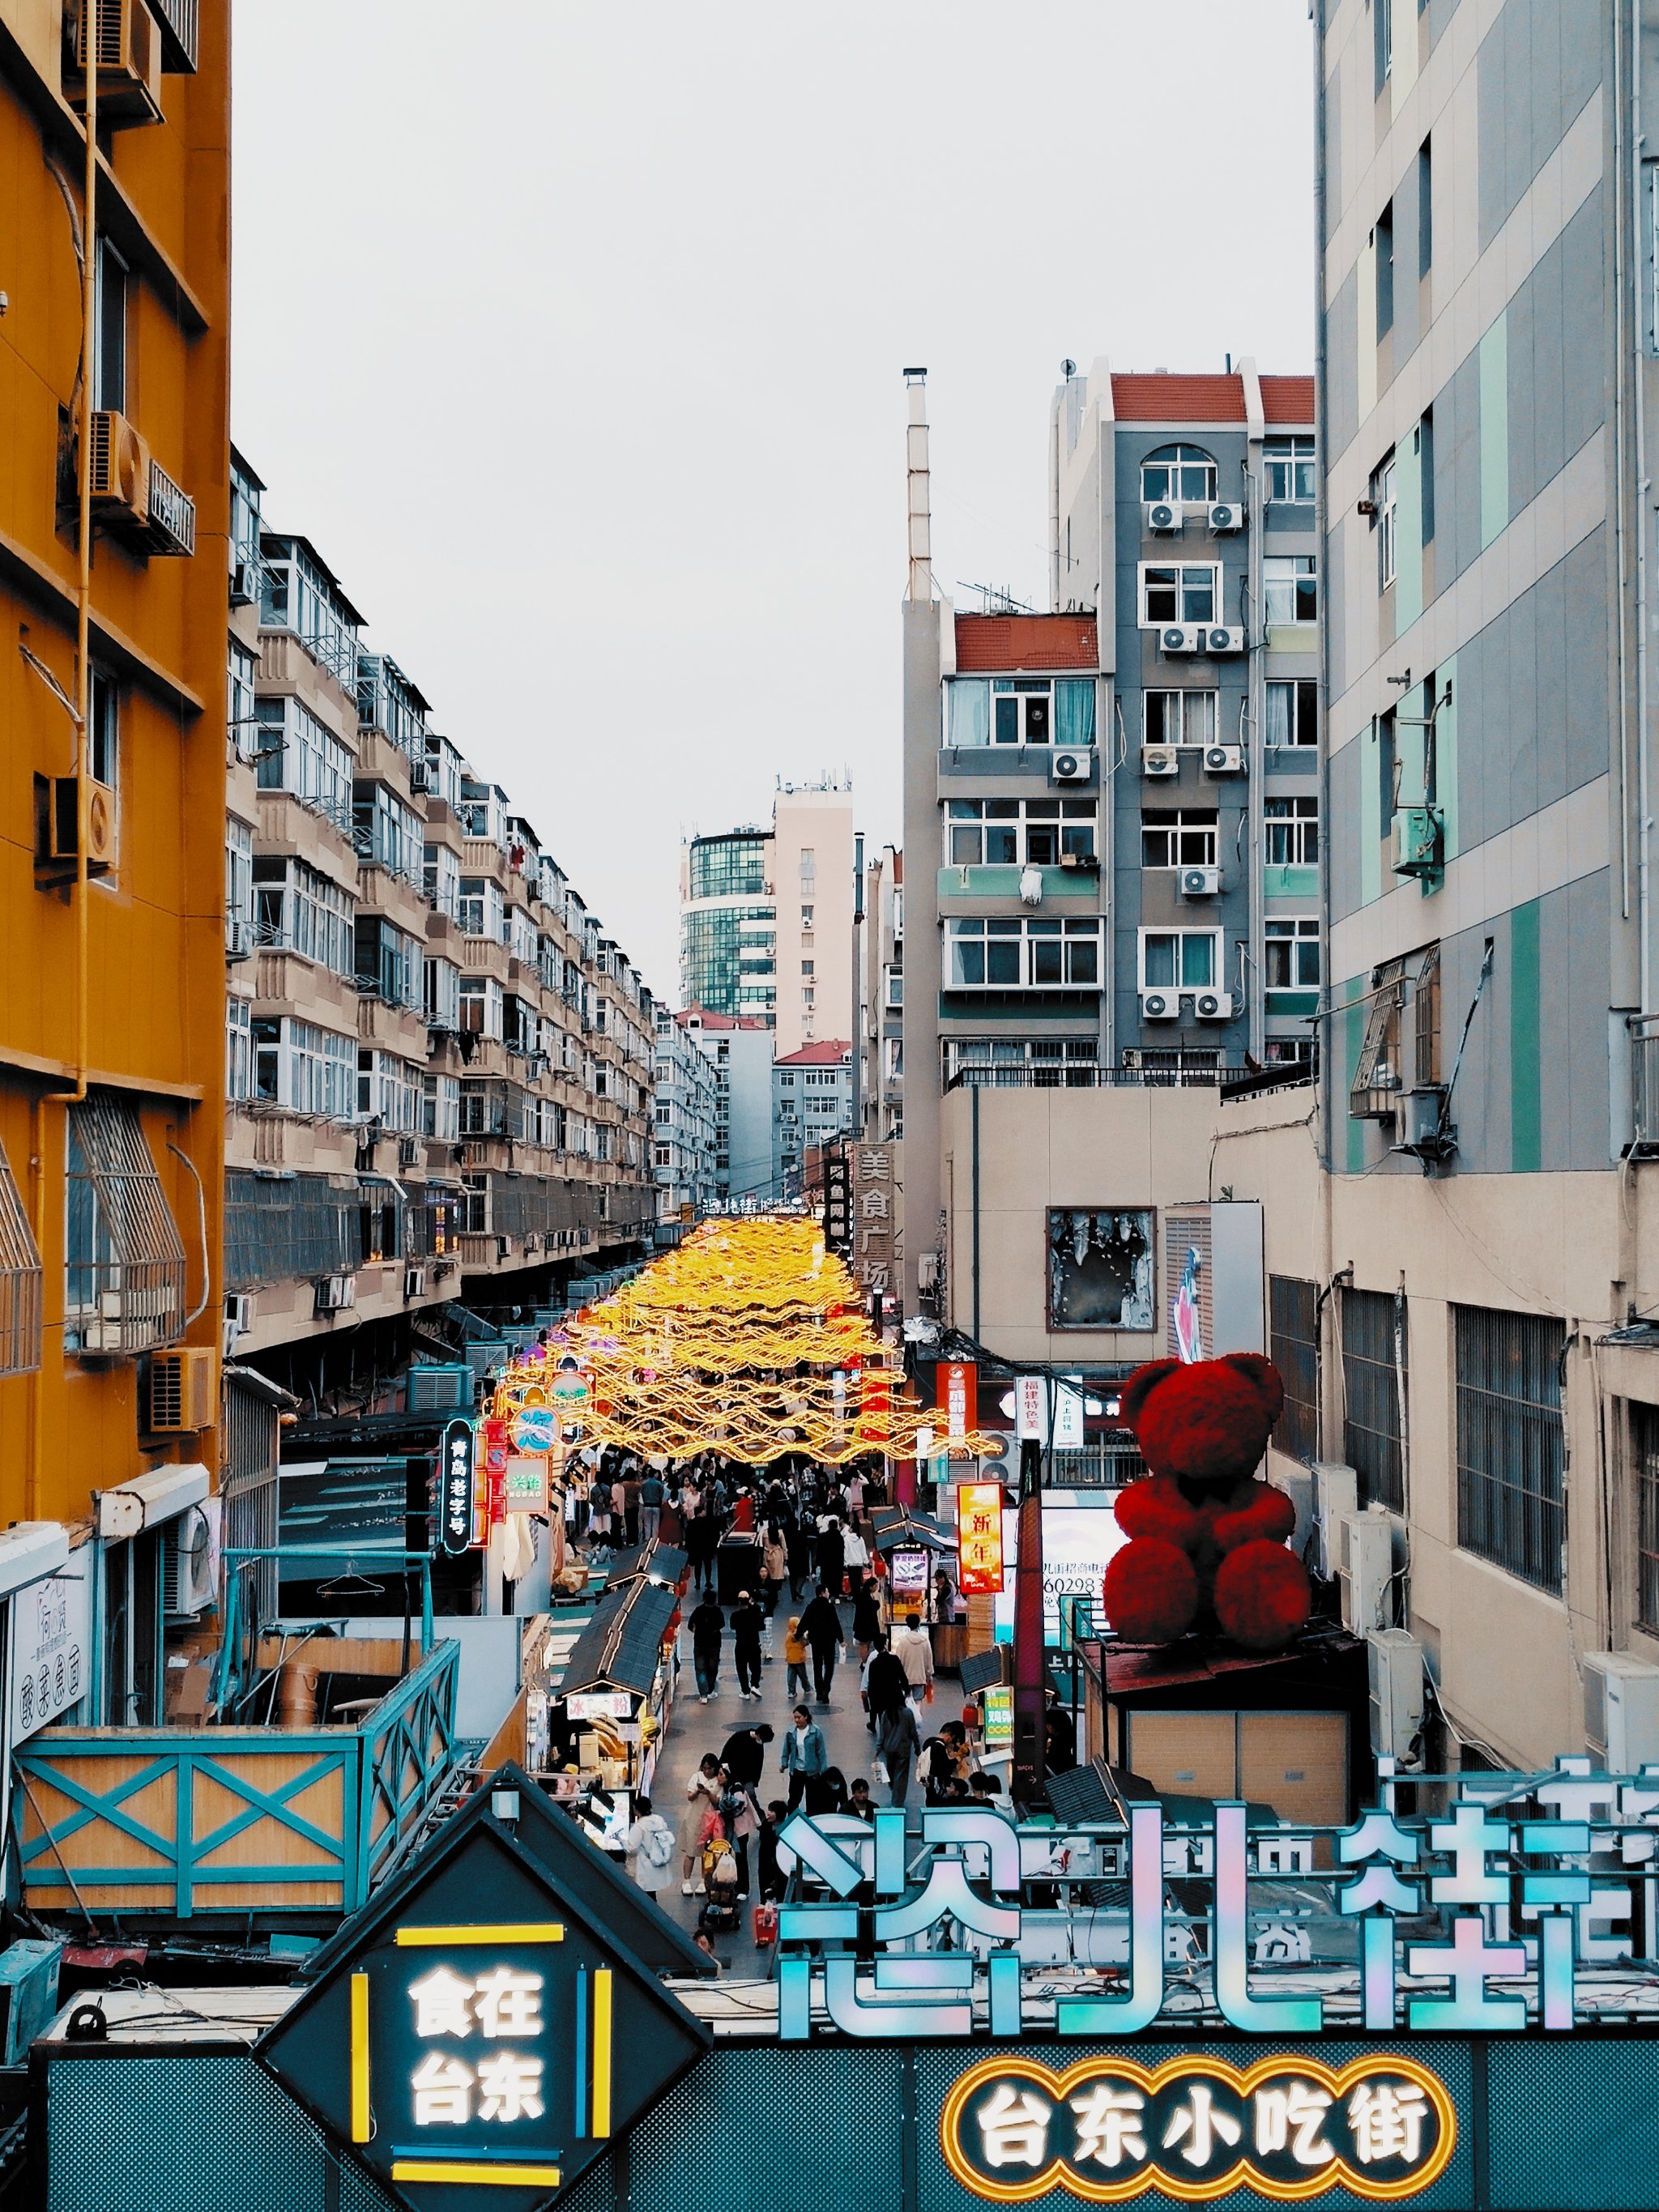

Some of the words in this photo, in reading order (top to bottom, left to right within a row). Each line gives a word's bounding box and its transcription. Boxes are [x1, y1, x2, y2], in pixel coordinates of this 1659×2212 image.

[859, 1151, 890, 1289] 美食广场
[448, 1440, 467, 1536] 青岛老字号
[506, 1473, 541, 1490] 兴路
[972, 1514, 992, 1563] 新年
[407, 1968, 544, 2039] 食在
[412, 2053, 544, 2126] 台东
[978, 2082, 1429, 2168] 台东小吃街
